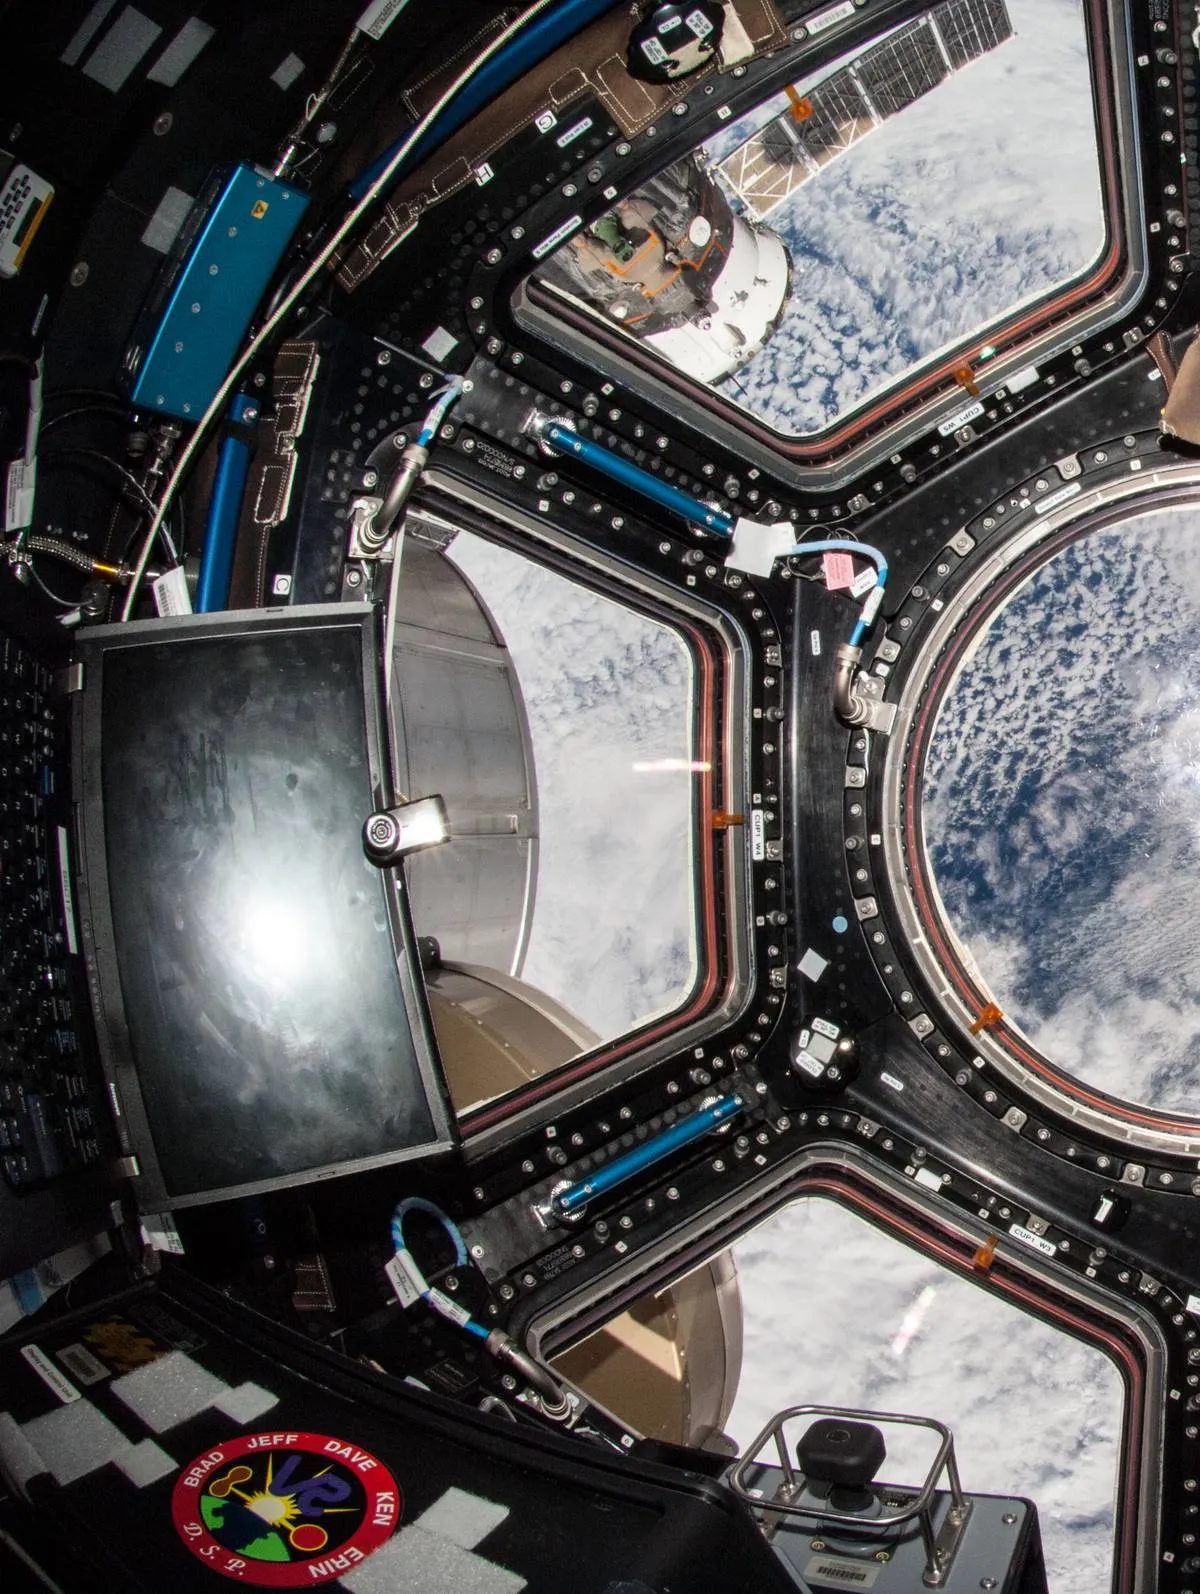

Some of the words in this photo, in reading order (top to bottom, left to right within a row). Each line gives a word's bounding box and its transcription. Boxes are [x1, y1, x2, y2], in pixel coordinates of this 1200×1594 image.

[538, 115, 554, 130] G
[476, 166, 491, 184] H
[959, 407, 980, 422] CUP1
[943, 422, 957, 432] W5
[275, 577, 290, 592] C
[754, 814, 762, 837] CUP1
[754, 843, 762, 855] W4
[1013, 1228, 1036, 1244] CUP1
[1039, 1241, 1052, 1253] W3
[248, 1434, 299, 1449] JEFF
[324, 1440, 377, 1473] DAVE
[184, 1451, 225, 1488] BRAD
[372, 1490, 394, 1527] KEN
[308, 1546, 366, 1579] ERIN
